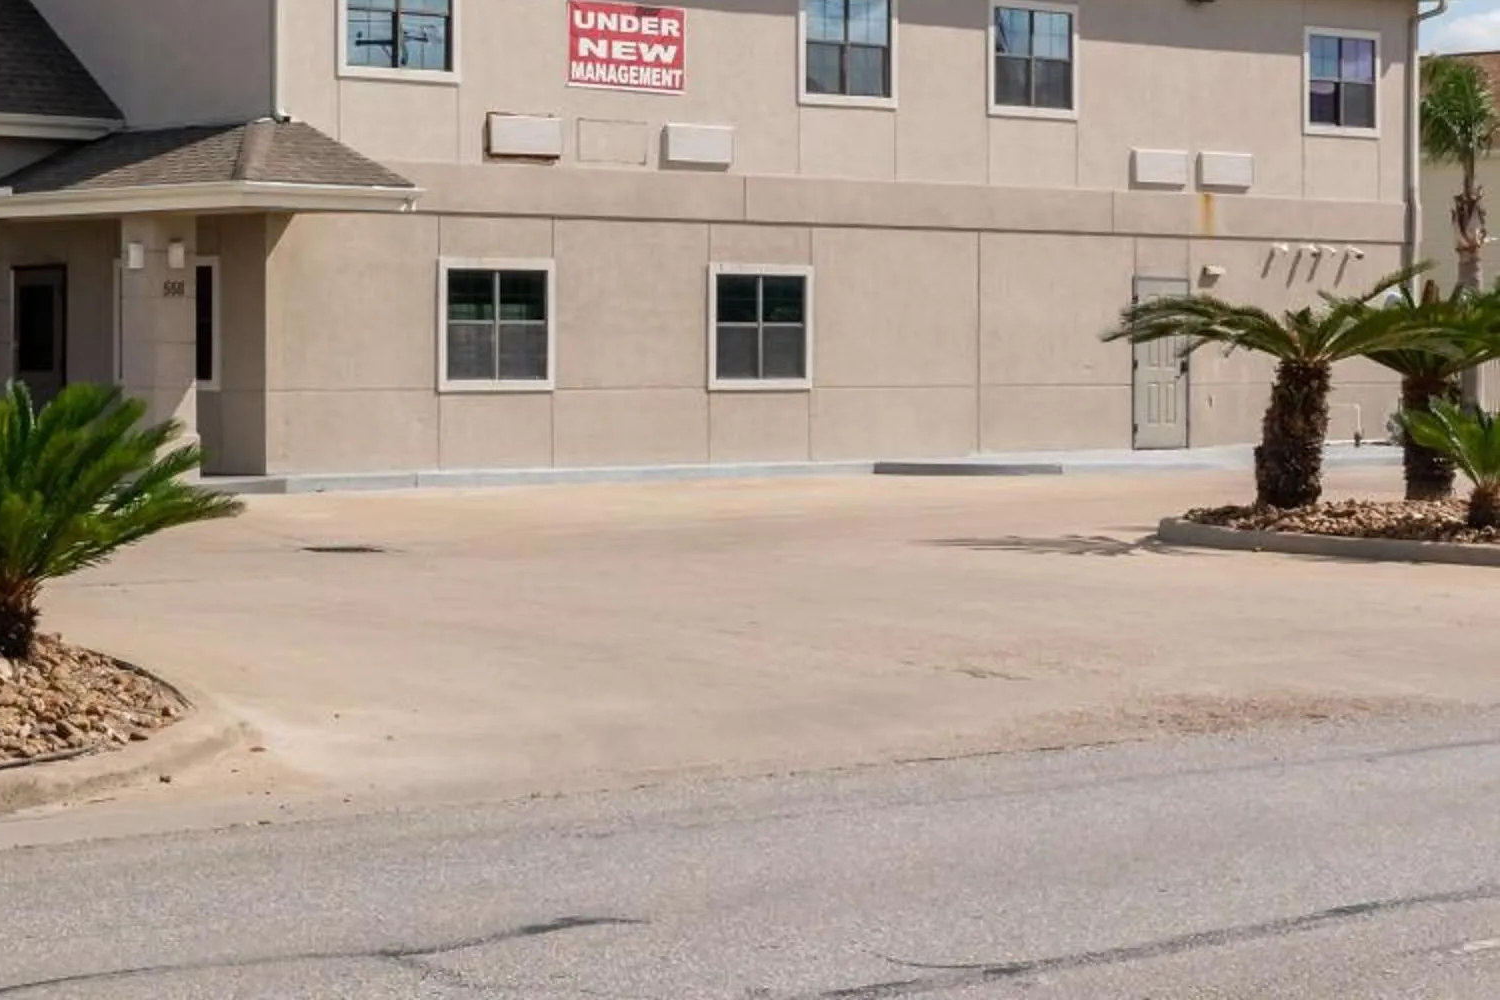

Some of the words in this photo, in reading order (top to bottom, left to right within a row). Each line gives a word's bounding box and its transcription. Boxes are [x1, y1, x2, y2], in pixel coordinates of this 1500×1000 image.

[573, 10, 681, 37] UNDER
[578, 37, 677, 63] NEW
[571, 61, 683, 88] MANAGEMENT
